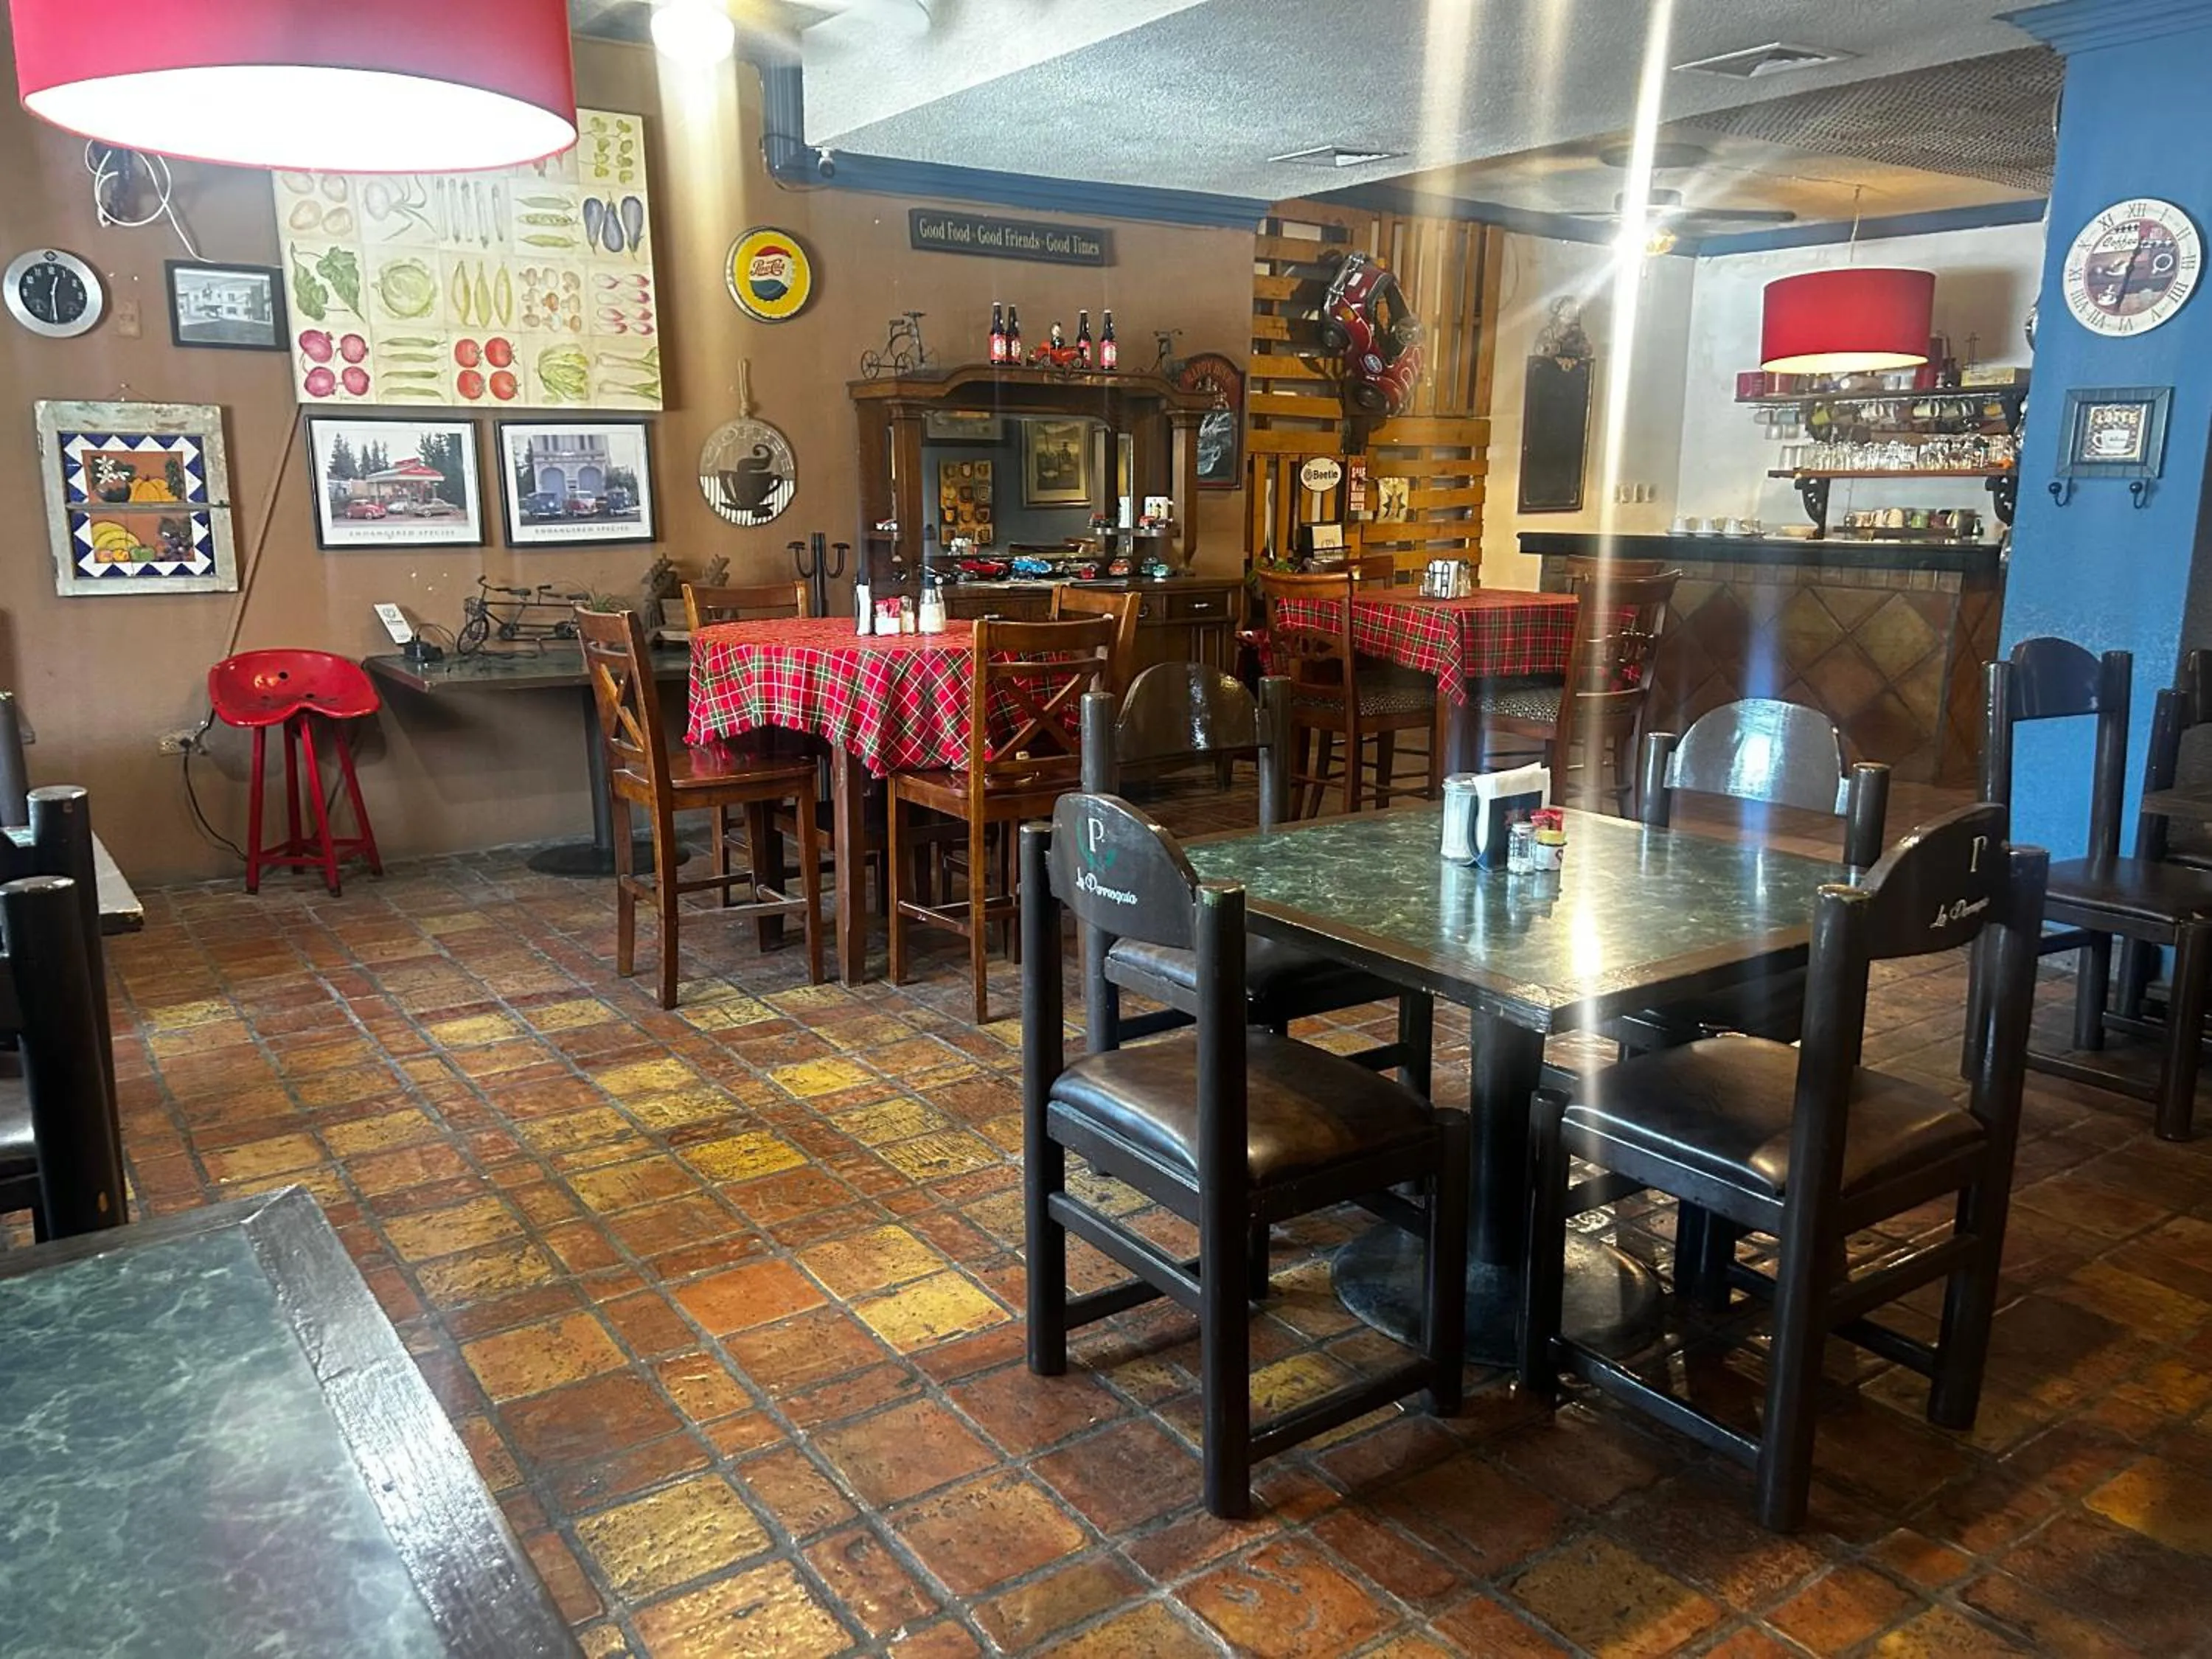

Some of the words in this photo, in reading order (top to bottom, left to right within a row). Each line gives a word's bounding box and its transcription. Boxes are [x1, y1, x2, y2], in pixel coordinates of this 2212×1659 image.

[2127, 203, 2147, 218] XII
[919, 218, 945, 239] Good
[947, 222, 970, 243] Food
[978, 225, 1002, 246] Good
[1005, 228, 1040, 249] Friends
[1046, 233, 1070, 252] Good
[1073, 235, 1099, 255] Times
[2102, 235, 2139, 249] Coffee
[1313, 470, 1338, 480] Beetle
